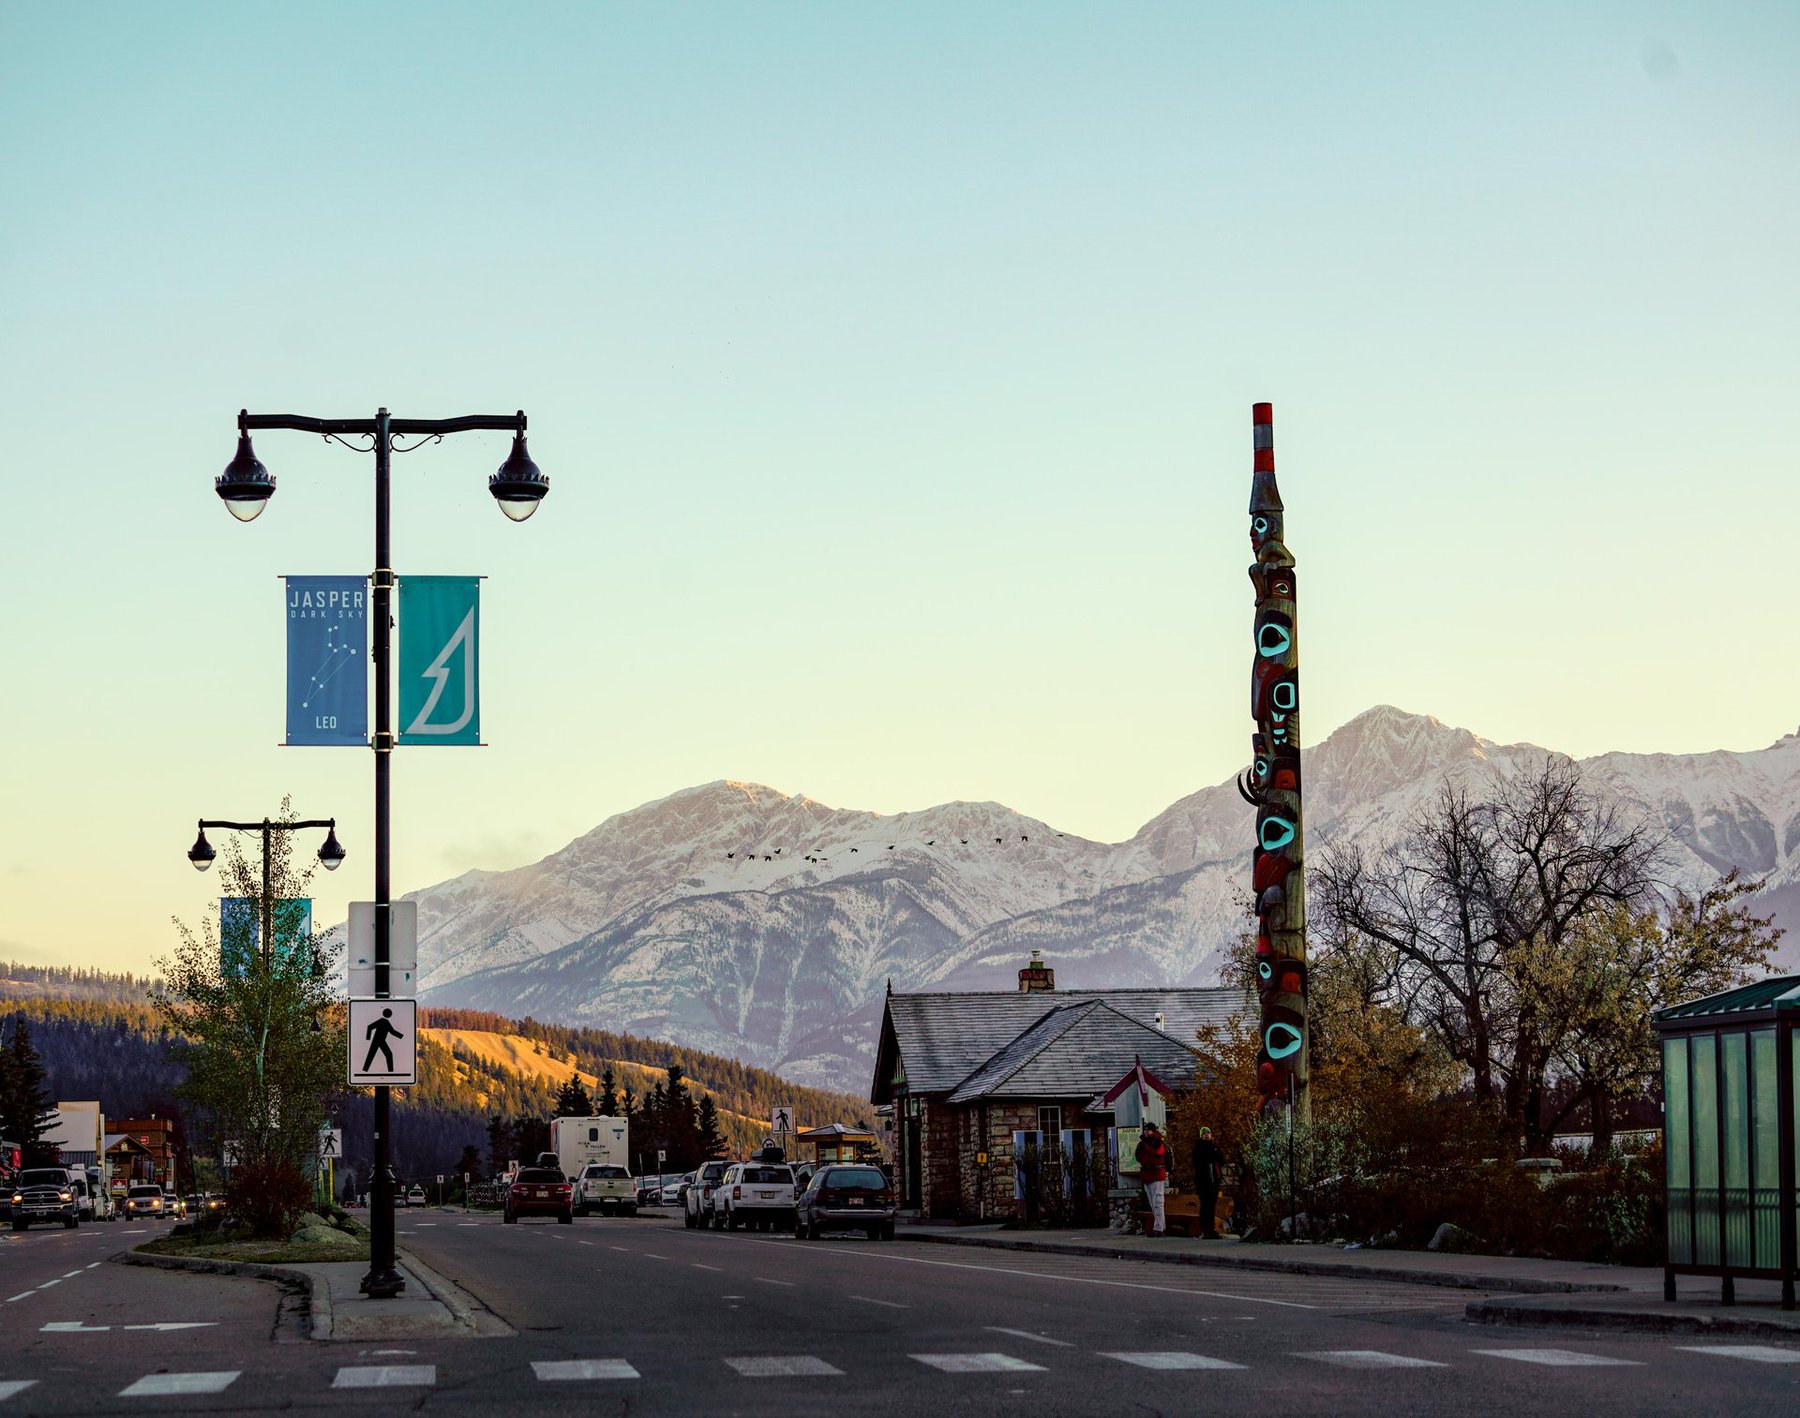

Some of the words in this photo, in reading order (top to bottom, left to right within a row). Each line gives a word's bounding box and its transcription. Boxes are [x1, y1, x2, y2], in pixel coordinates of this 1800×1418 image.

[290, 591, 363, 608] JASPER
[291, 610, 326, 619] DARK
[338, 610, 363, 619] SKY
[316, 716, 337, 729] LEO
